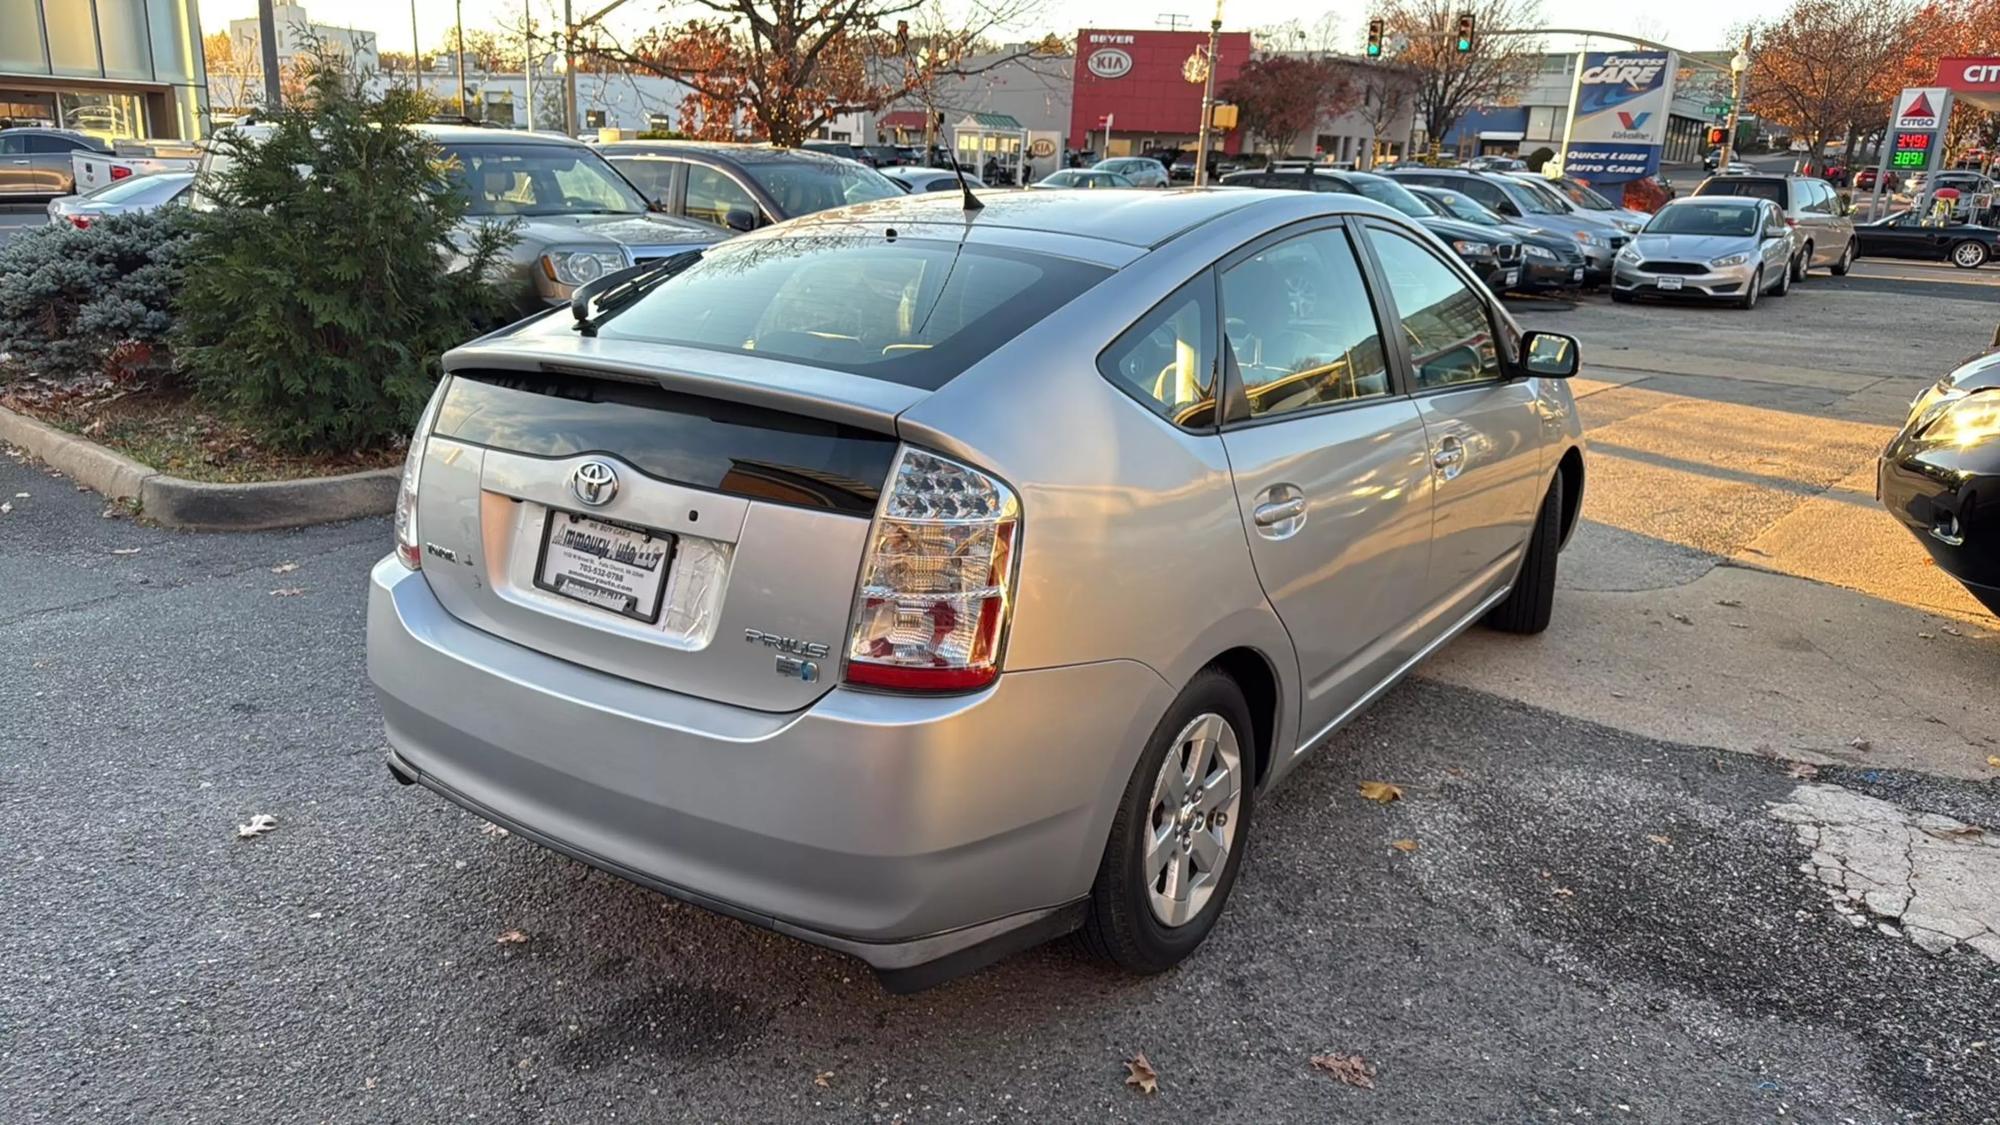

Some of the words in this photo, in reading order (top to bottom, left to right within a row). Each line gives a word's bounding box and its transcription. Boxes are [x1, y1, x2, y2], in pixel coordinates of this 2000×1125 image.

[1090, 34, 1134, 44] BEYER
[1096, 56, 1123, 69] KIA
[1603, 56, 1667, 67] Express
[1580, 66, 1662, 90] CARE
[1900, 118, 1934, 127] CITGO
[1034, 143, 1051, 154] KIA
[1567, 151, 1609, 160] QUICK
[1609, 152, 1648, 161] LUBE
[1565, 163, 1604, 172] AUTO
[1606, 164, 1646, 174] CARE
[600, 524, 613, 533] BUY
[613, 528, 632, 538] CARS
[551, 523, 611, 559] Ammoury
[609, 538, 637, 563] Auto
[745, 627, 830, 659] PRIUS
